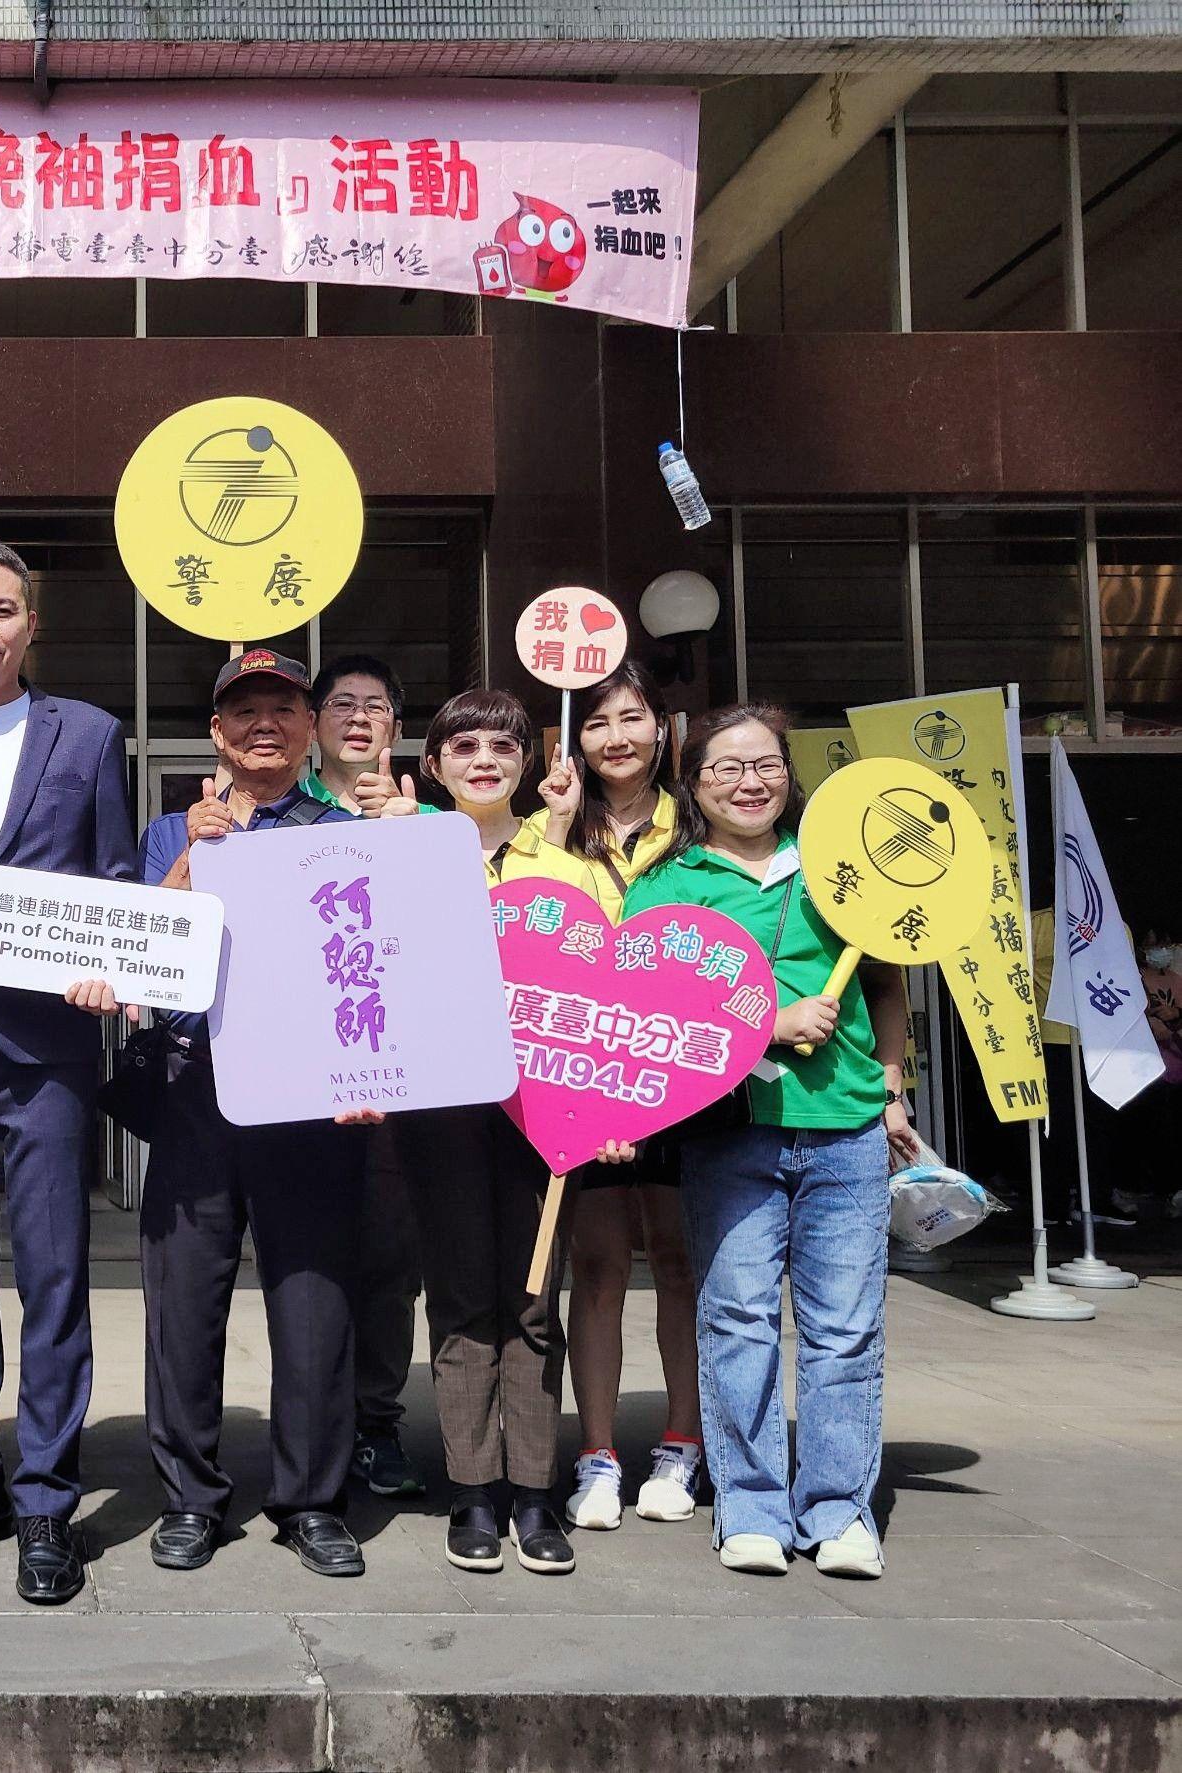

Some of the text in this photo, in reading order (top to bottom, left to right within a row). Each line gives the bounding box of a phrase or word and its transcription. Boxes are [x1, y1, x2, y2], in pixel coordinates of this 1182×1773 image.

[587, 187, 661, 215] 一起來
[535, 601, 569, 632] 我
[532, 641, 607, 674] 捐血
[299, 845, 373, 870] SINCE 1960
[21, 920, 43, 938] of
[47, 925, 105, 947] Chain
[111, 938, 148, 953] and
[0, 941, 108, 972] Promotion,
[115, 957, 185, 980] Taiwan
[503, 986, 730, 1072] 廣臺中分臺
[330, 1067, 405, 1085] MASTER
[332, 1085, 408, 1104] A-TSUNG
